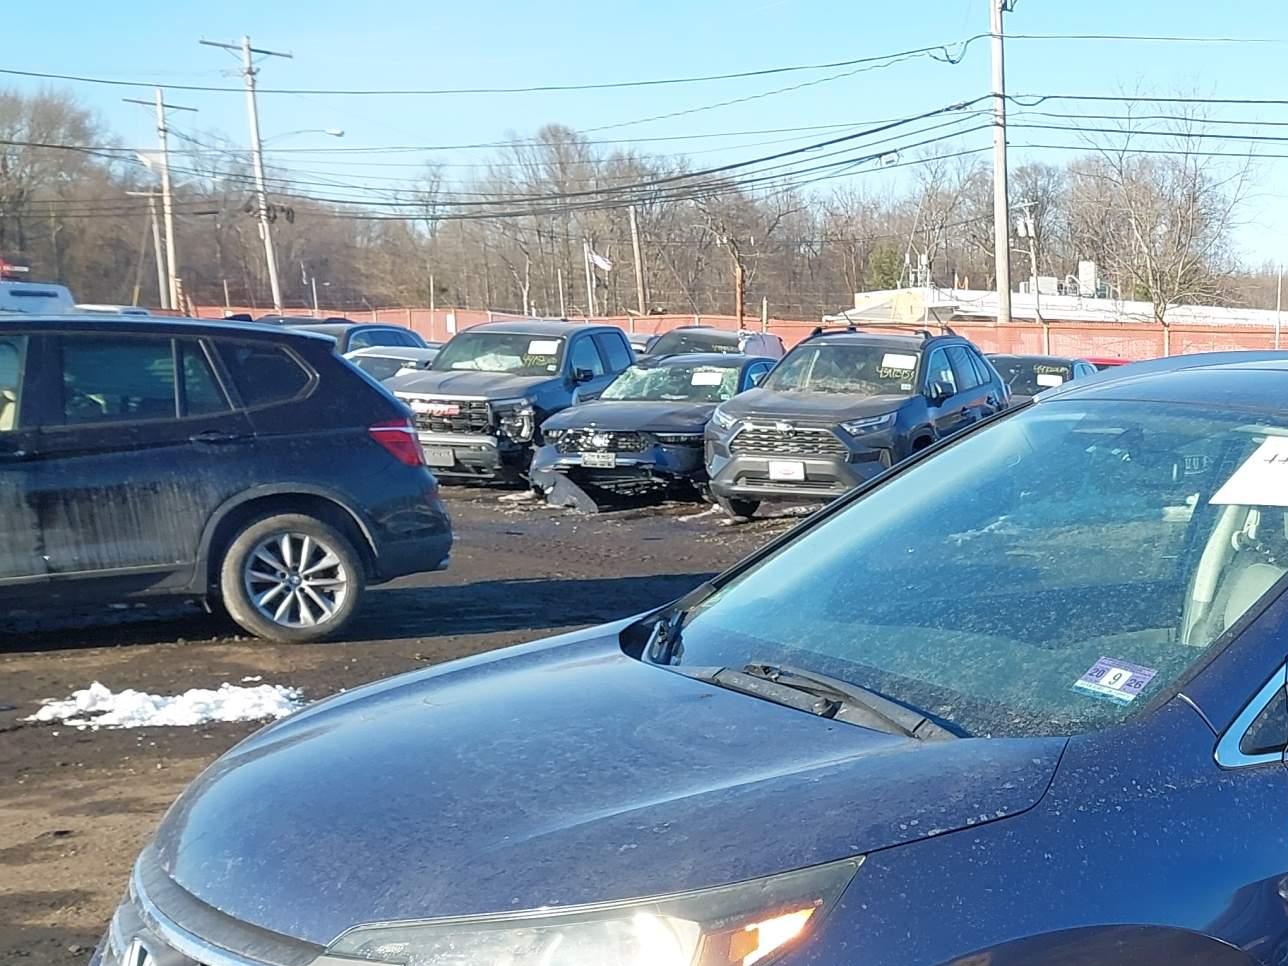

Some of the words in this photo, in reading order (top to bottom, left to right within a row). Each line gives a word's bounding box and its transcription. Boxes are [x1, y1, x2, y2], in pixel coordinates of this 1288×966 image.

[1088, 668, 1105, 678] 20
[1109, 673, 1122, 685] 9
[1126, 679, 1144, 689] 26
